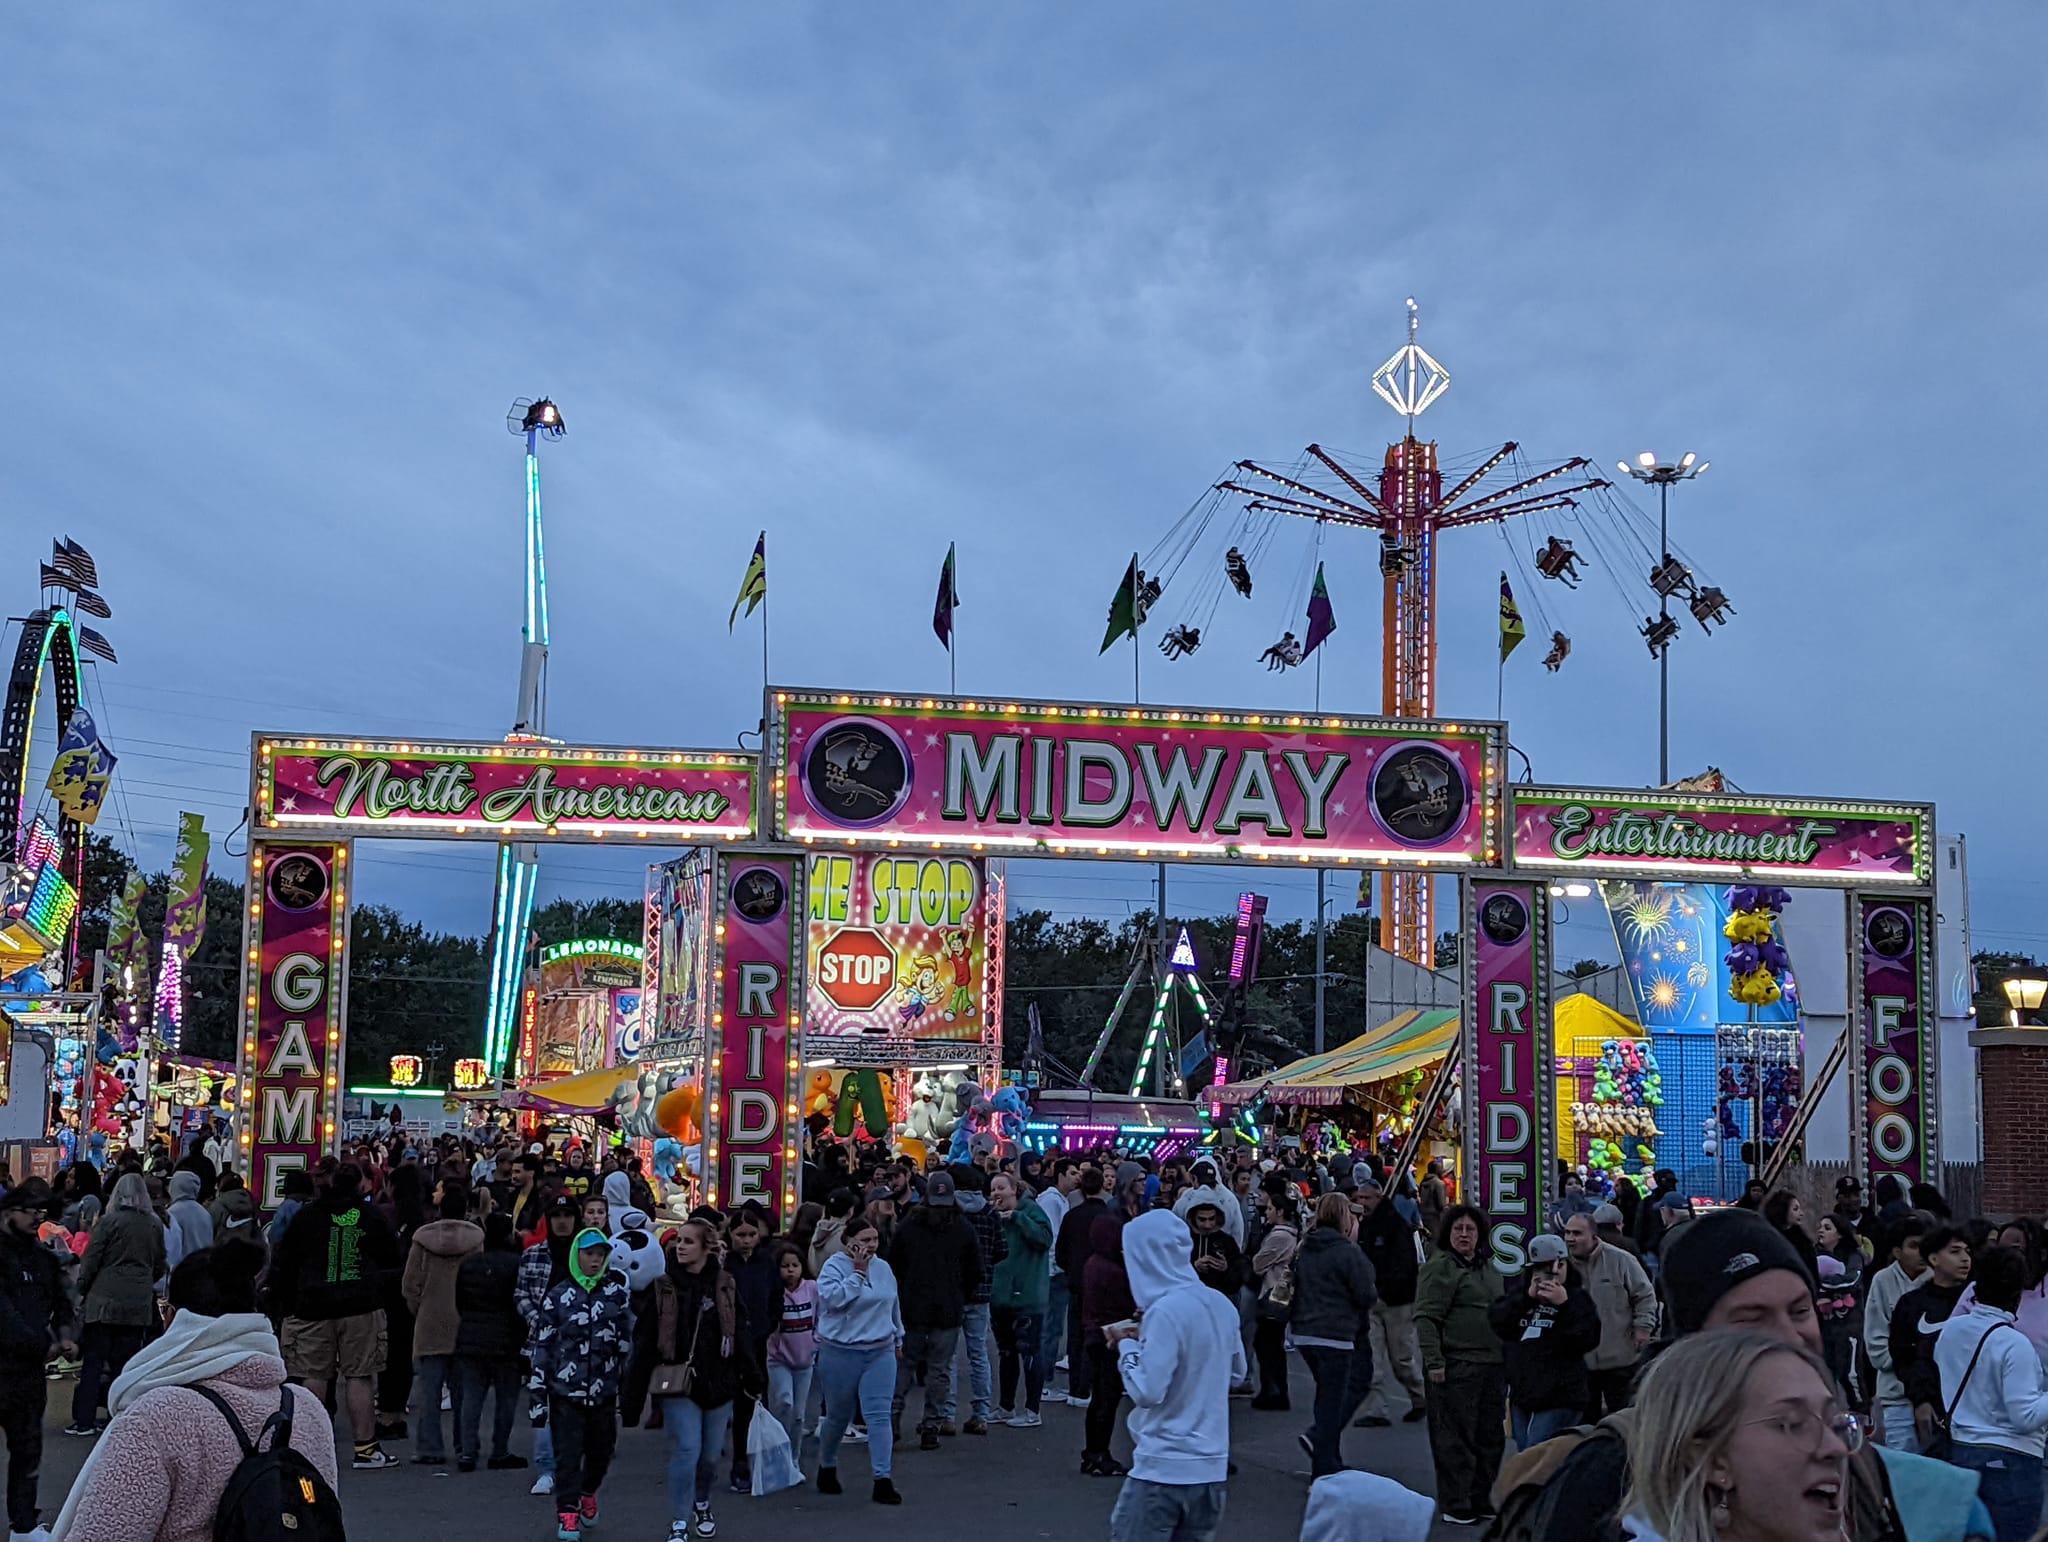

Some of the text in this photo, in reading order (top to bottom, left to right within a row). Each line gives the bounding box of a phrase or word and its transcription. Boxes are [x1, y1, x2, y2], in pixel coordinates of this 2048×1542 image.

[317, 755, 730, 825] North American
[941, 731, 1351, 838] MIDWAY
[1549, 803, 1837, 862] Entertainment
[873, 857, 974, 926] STOP
[549, 939, 644, 961] LEMONADE
[821, 952, 891, 985] STOP
[258, 952, 325, 1230] GAME
[728, 961, 781, 1208] RIDE
[1485, 982, 1531, 1277] RIDES
